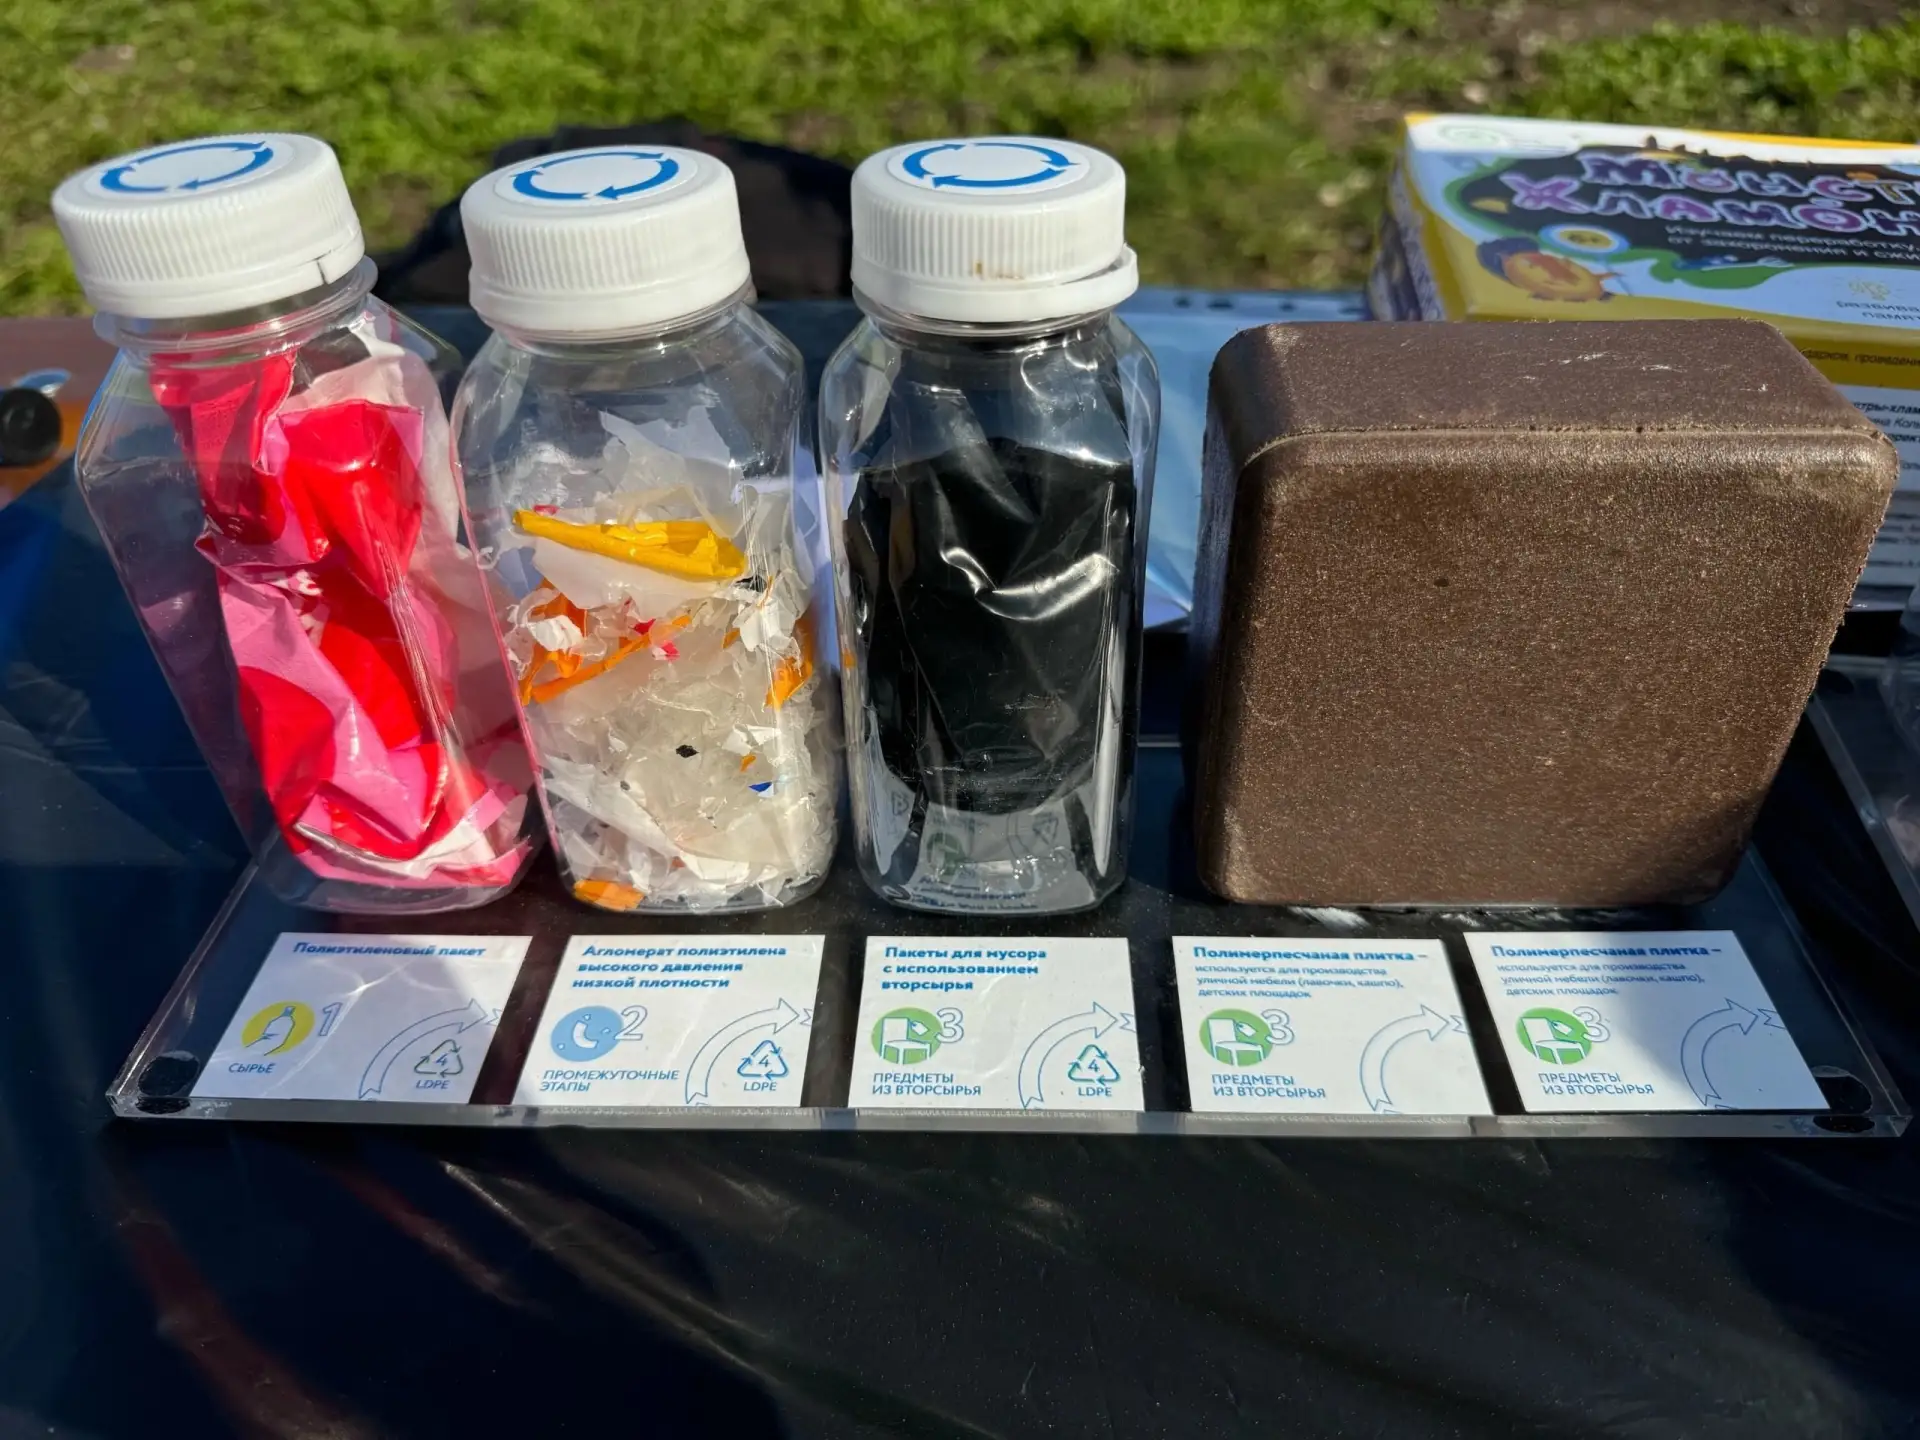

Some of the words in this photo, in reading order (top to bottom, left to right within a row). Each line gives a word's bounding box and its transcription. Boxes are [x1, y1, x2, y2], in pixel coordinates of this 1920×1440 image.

[1577, 152, 1920, 205] МОНСТ
[293, 941, 434, 956] Полиэтиленовый
[438, 946, 486, 957] пакет
[582, 946, 674, 958] Агломерат
[677, 946, 787, 957] полиэтилена
[884, 946, 948, 959] Пакеты
[951, 948, 984, 960] для
[986, 948, 1047, 961] мусора
[1192, 946, 1350, 961] Полимерпесчаная
[1354, 951, 1414, 961] плитка
[1490, 945, 1646, 960] Полимерпесчаная
[1650, 946, 1709, 956] плитка
[577, 961, 658, 973] высокого
[661, 961, 744, 973] давления
[882, 964, 892, 974] с
[895, 964, 1039, 975] использованием
[1195, 965, 1275, 976] используется
[1278, 967, 1300, 976] для
[1302, 966, 1387, 977] производства
[1496, 963, 1577, 974] используется
[1579, 963, 1600, 973] для
[1602, 962, 1687, 973] производства
[572, 976, 636, 988] низкой
[639, 978, 730, 988] плотности
[1197, 976, 1248, 987] уличной
[1250, 976, 1296, 986] мебели
[1501, 973, 1551, 985] уличной
[1554, 974, 1600, 984] мебели
[881, 980, 974, 992] вторсырья
[1506, 986, 1555, 996] детских
[1198, 988, 1248, 998] детских
[1249, 989, 1312, 999] площадок
[319, 1001, 343, 1037] 1
[614, 1004, 648, 1041] 2
[935, 1007, 965, 1043] 3
[1572, 1006, 1611, 1043] 3
[1261, 1008, 1295, 1046] 3
[436, 1053, 449, 1067] 4
[758, 1054, 771, 1068] 4
[1087, 1059, 1100, 1073] 4
[542, 1069, 681, 1081] ПРОМЕЖУТОЧНЫЕ
[872, 1072, 954, 1085] ПРЕДМЕТЫ
[1211, 1073, 1294, 1086] ПРЕДМЕТЫ
[1538, 1071, 1621, 1084] ПРЕДМЕТЫ
[415, 1079, 450, 1090] LDPE
[538, 1081, 592, 1092] ЭТАПЫ
[743, 1081, 777, 1092] LDPE
[1543, 1084, 1564, 1095] ИЗ
[1566, 1084, 1655, 1096] ВТОРСЫРЬЯ
[872, 1085, 893, 1096] ИЗ
[895, 1085, 981, 1097] ВТОРСЫРЬЯ
[1077, 1086, 1112, 1097] LDPE
[1213, 1086, 1234, 1097] ИЗ
[1237, 1086, 1326, 1099] ВТОРСЫРЬЯ
